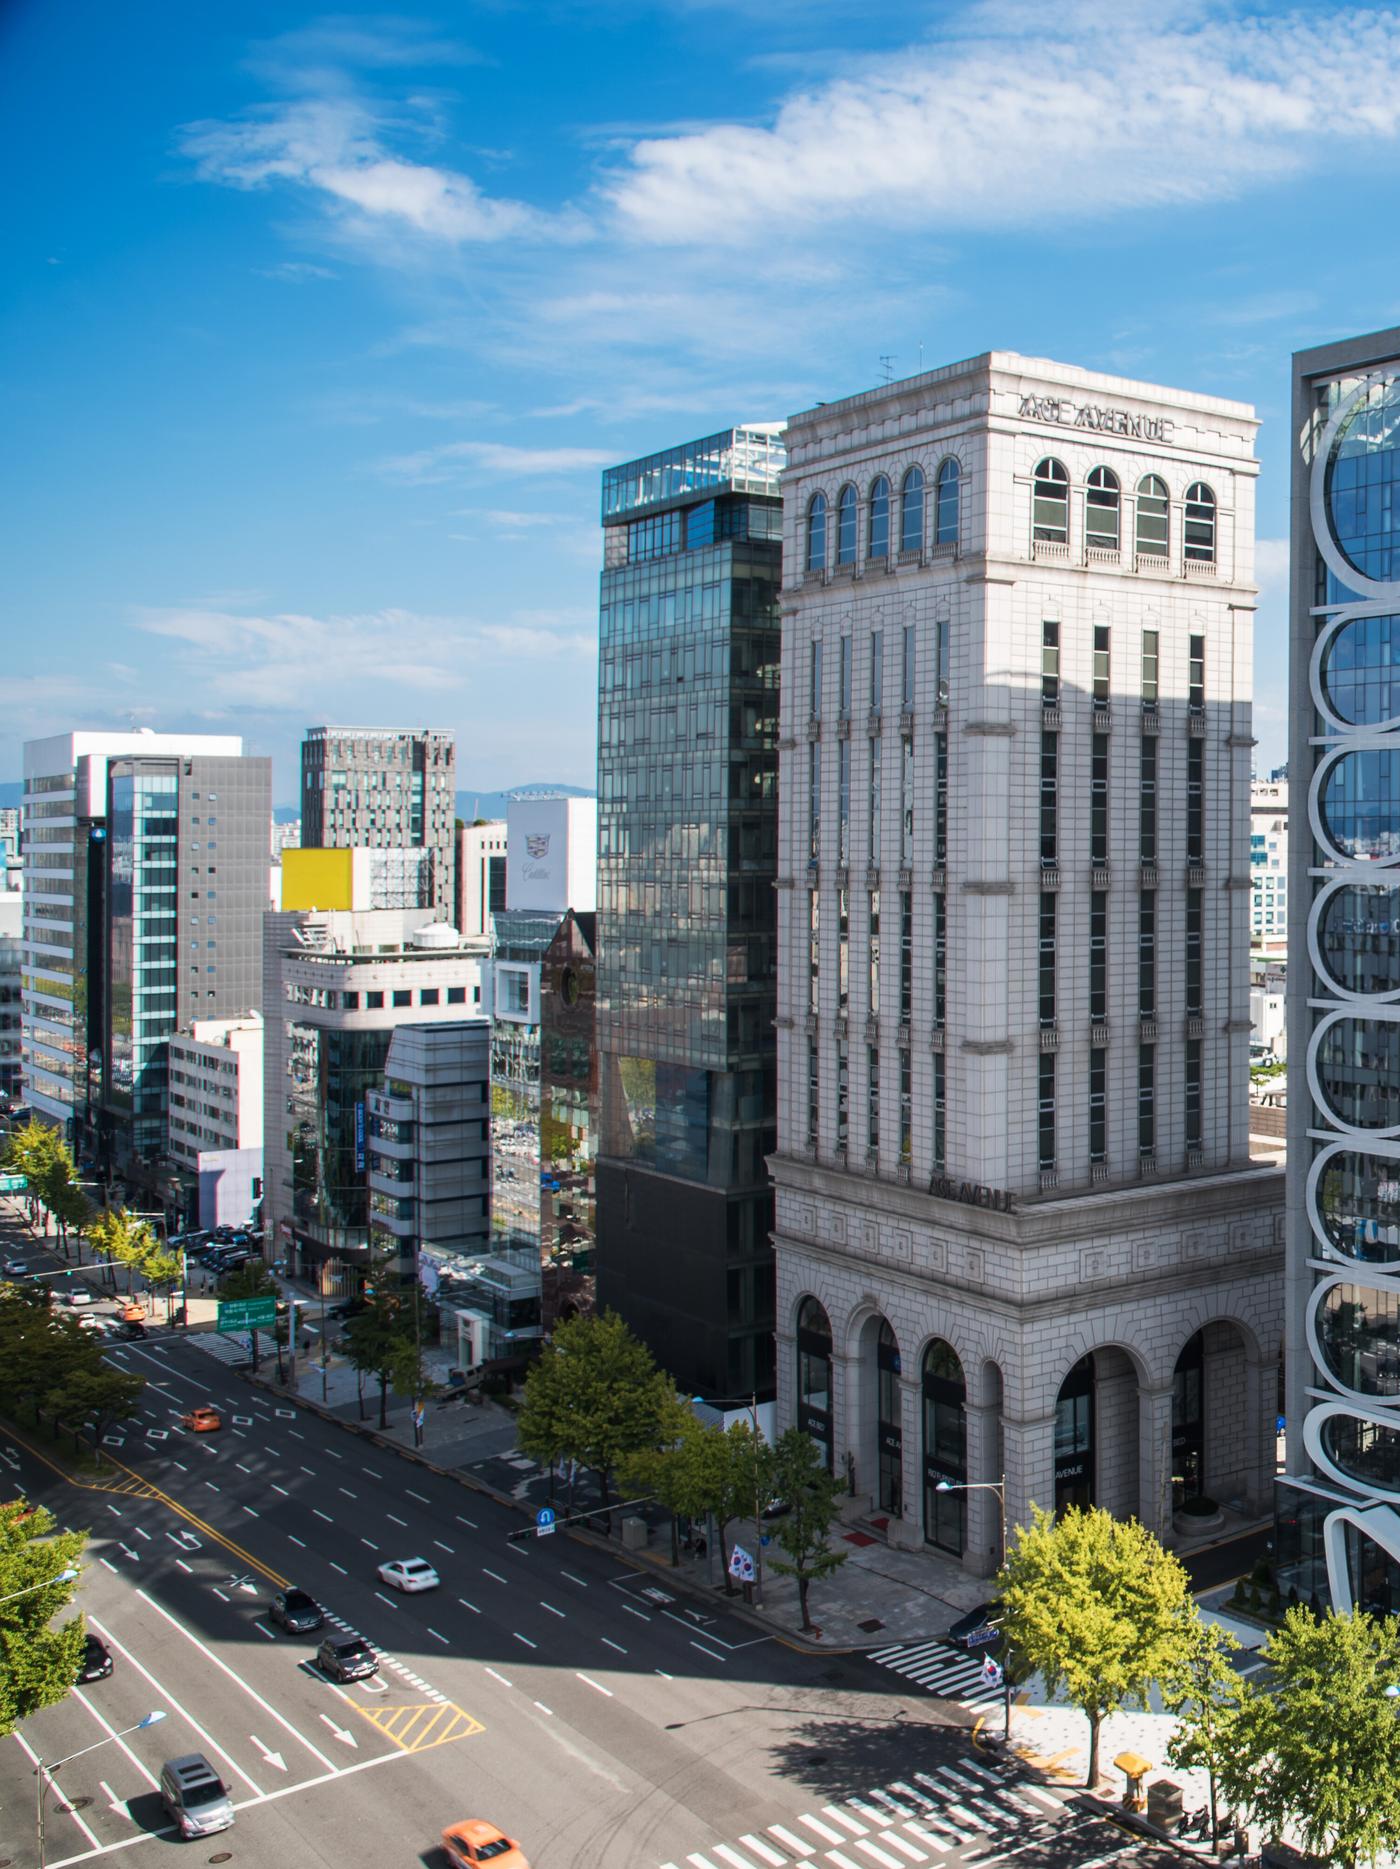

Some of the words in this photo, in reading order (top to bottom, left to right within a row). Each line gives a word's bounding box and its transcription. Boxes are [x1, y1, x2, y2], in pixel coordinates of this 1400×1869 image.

[1019, 392, 1073, 426] ACE
[1075, 403, 1175, 444] AVENUE
[1055, 1464, 1083, 1479] AVENUE
